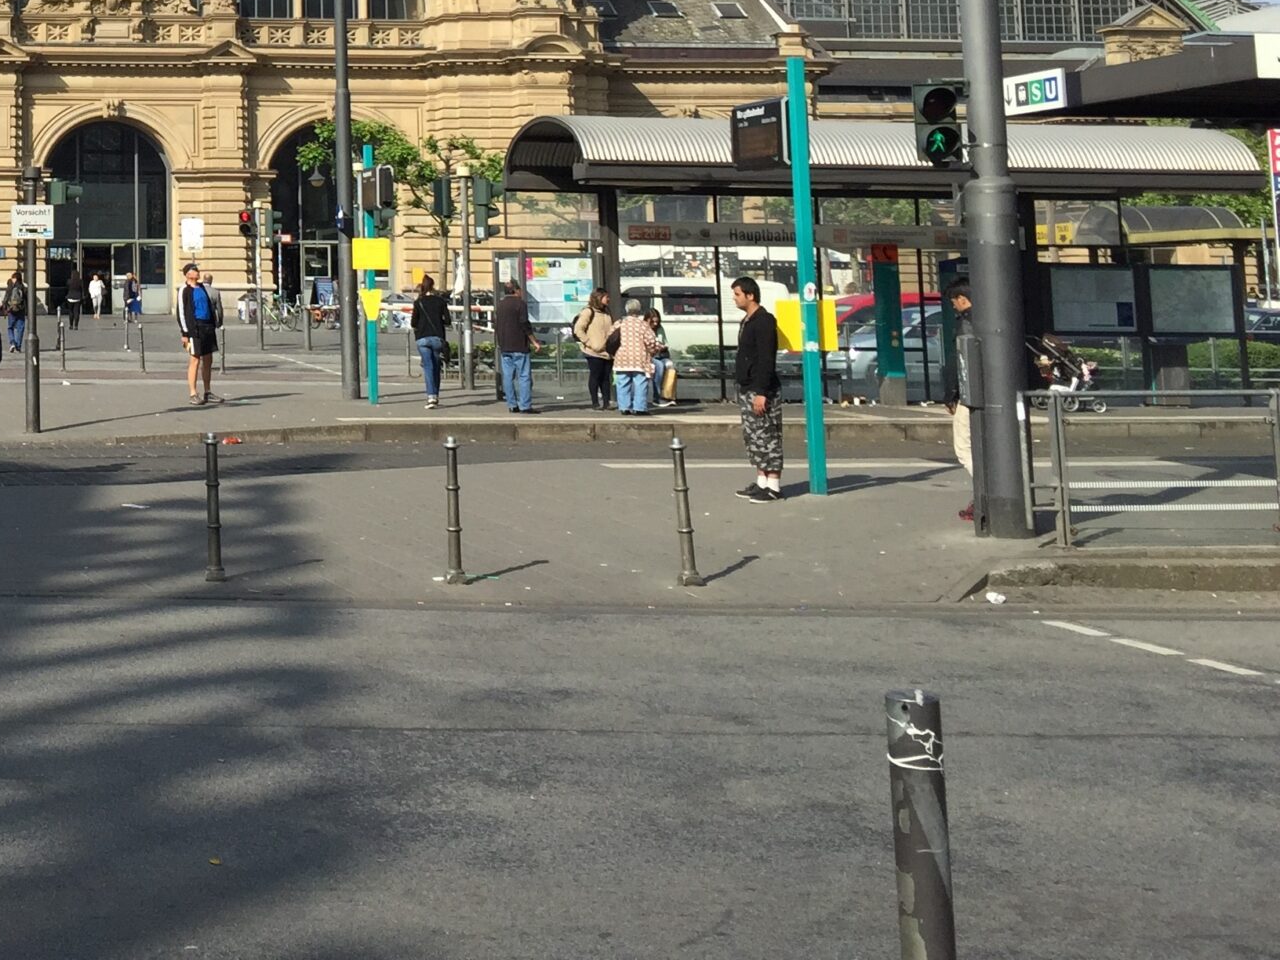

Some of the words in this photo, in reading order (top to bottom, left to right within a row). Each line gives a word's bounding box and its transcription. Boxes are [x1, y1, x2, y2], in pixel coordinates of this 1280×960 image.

[1031, 82, 1041, 101] S
[1045, 79, 1057, 99] U
[729, 227, 817, 244] Hauptbahn
